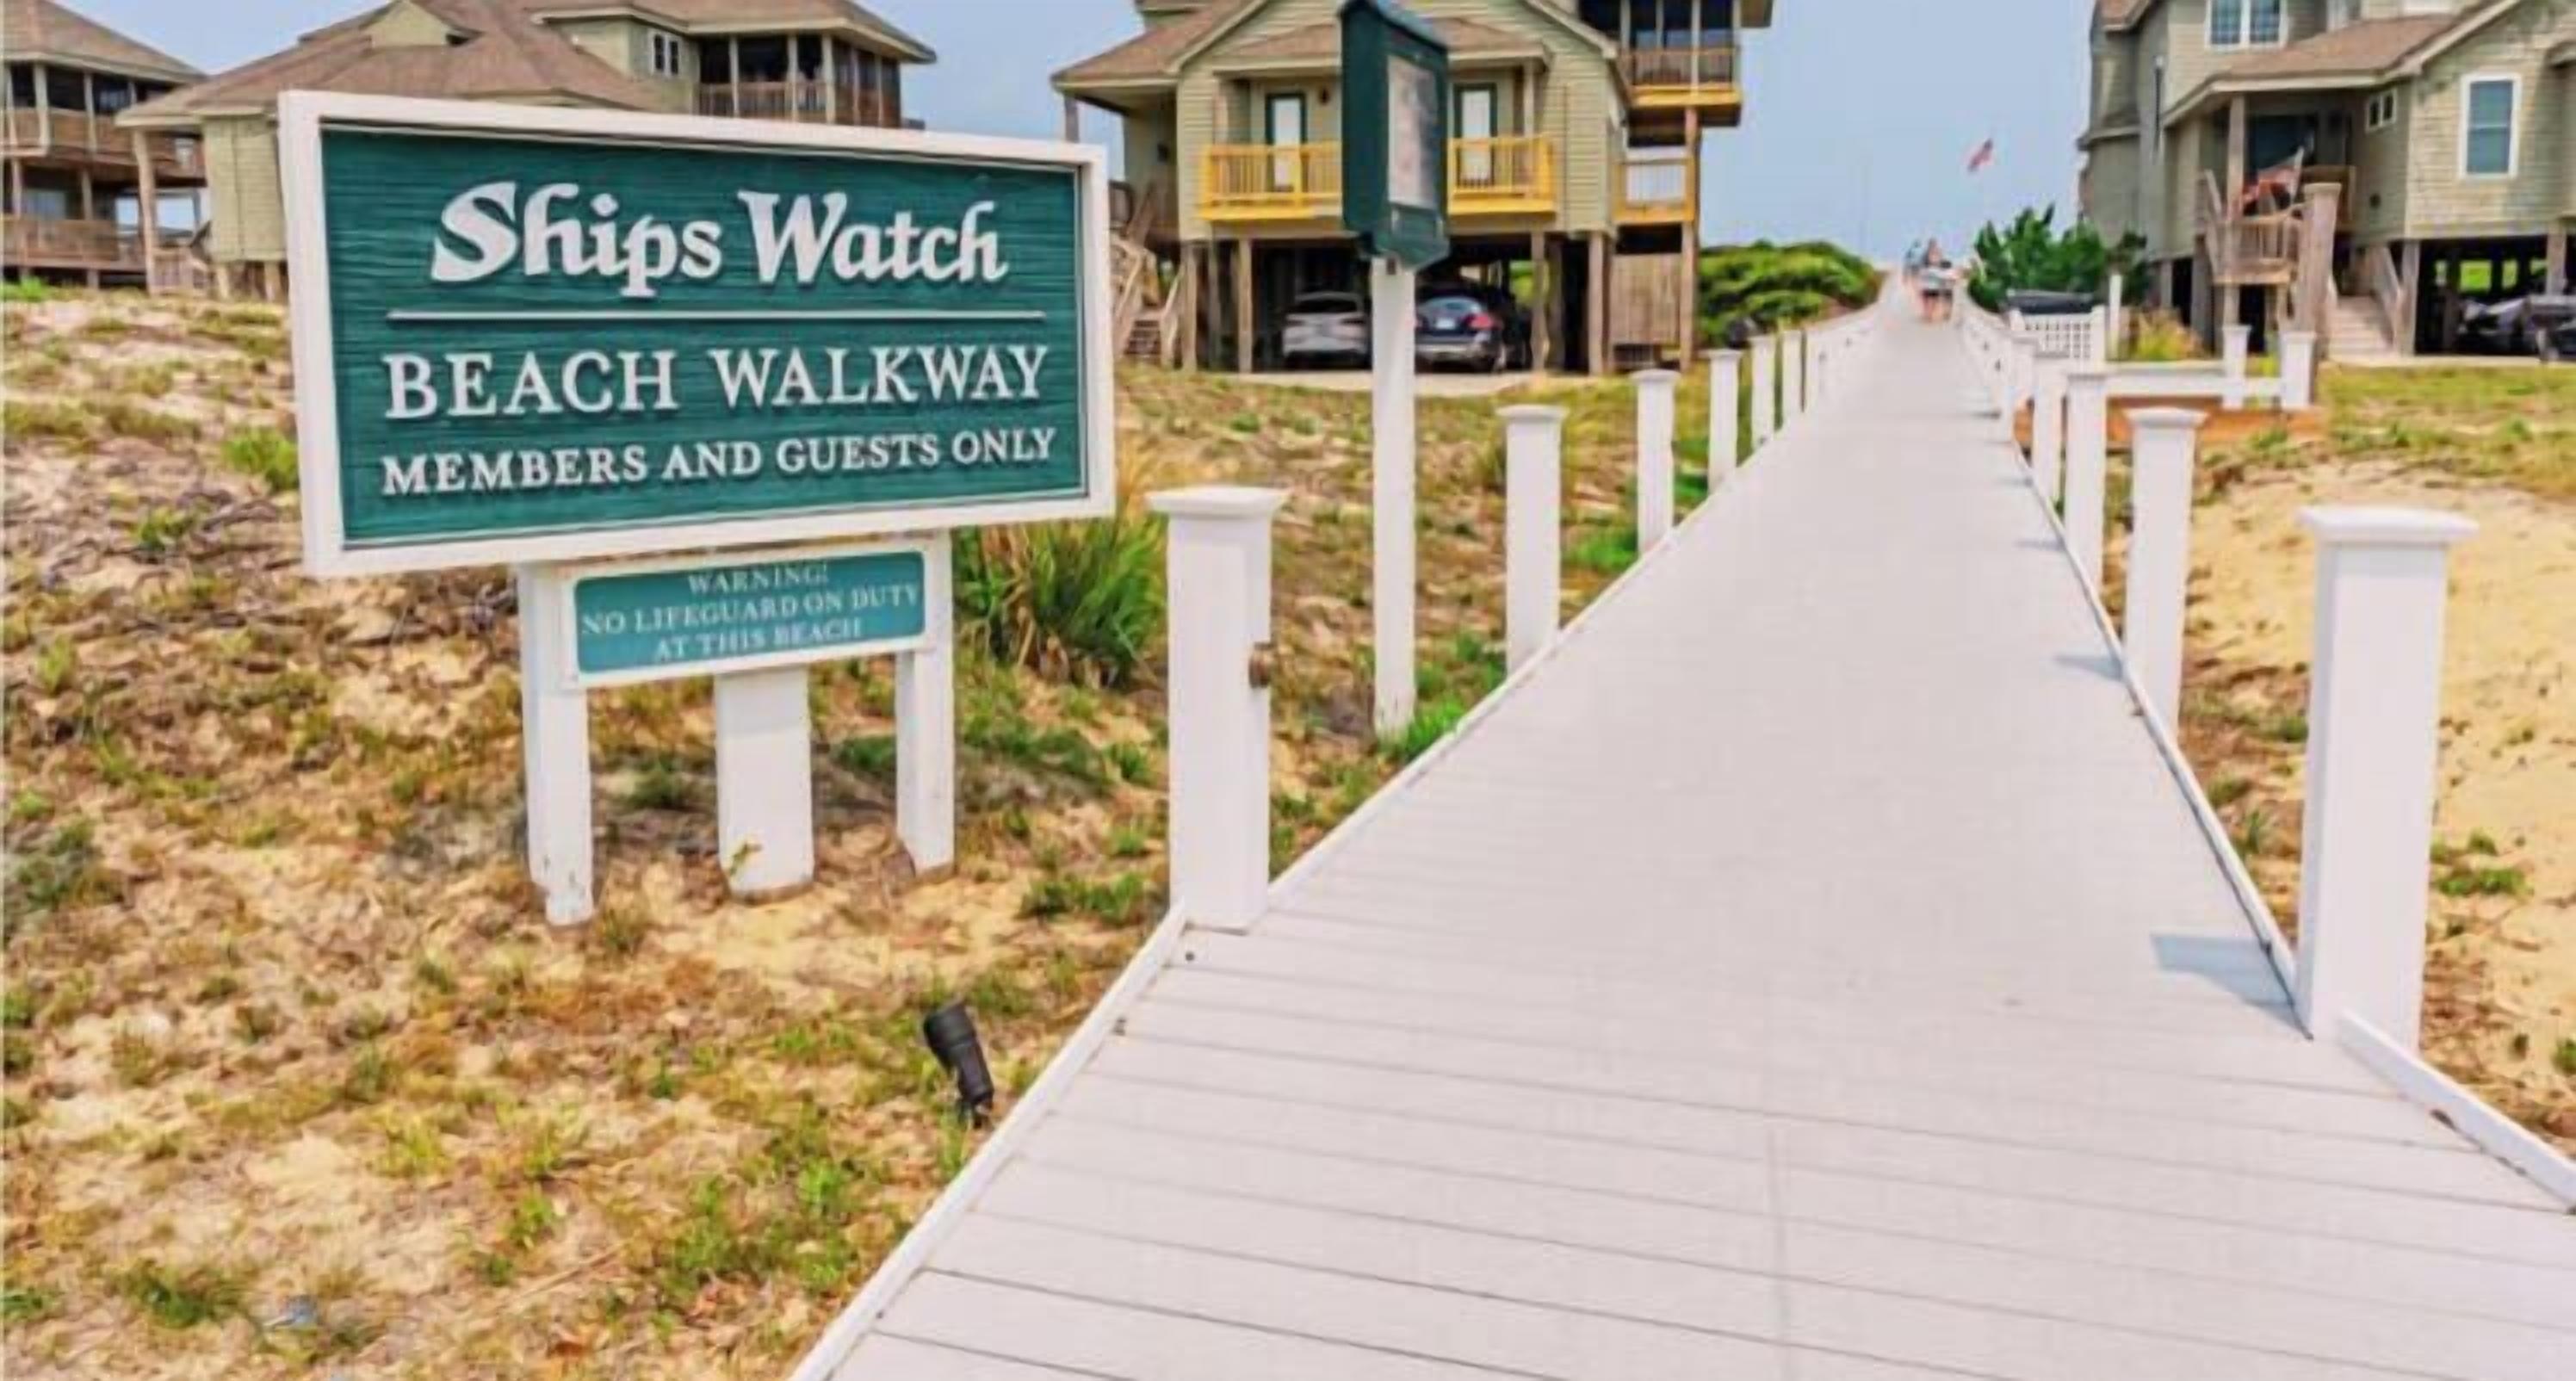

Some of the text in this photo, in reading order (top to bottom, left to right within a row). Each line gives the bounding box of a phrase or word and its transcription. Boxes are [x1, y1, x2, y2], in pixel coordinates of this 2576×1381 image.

[431, 182, 1008, 297] Ships Watch
[381, 345, 1049, 418] BEACH WALKWAY
[381, 428, 1056, 495] MEMBERS AND GUESTS ONLY
[688, 563, 828, 594] WARNING!
[582, 583, 920, 635] NO LIFEGUARD ON DUTY
[654, 618, 862, 662] AT THIS BEACH
